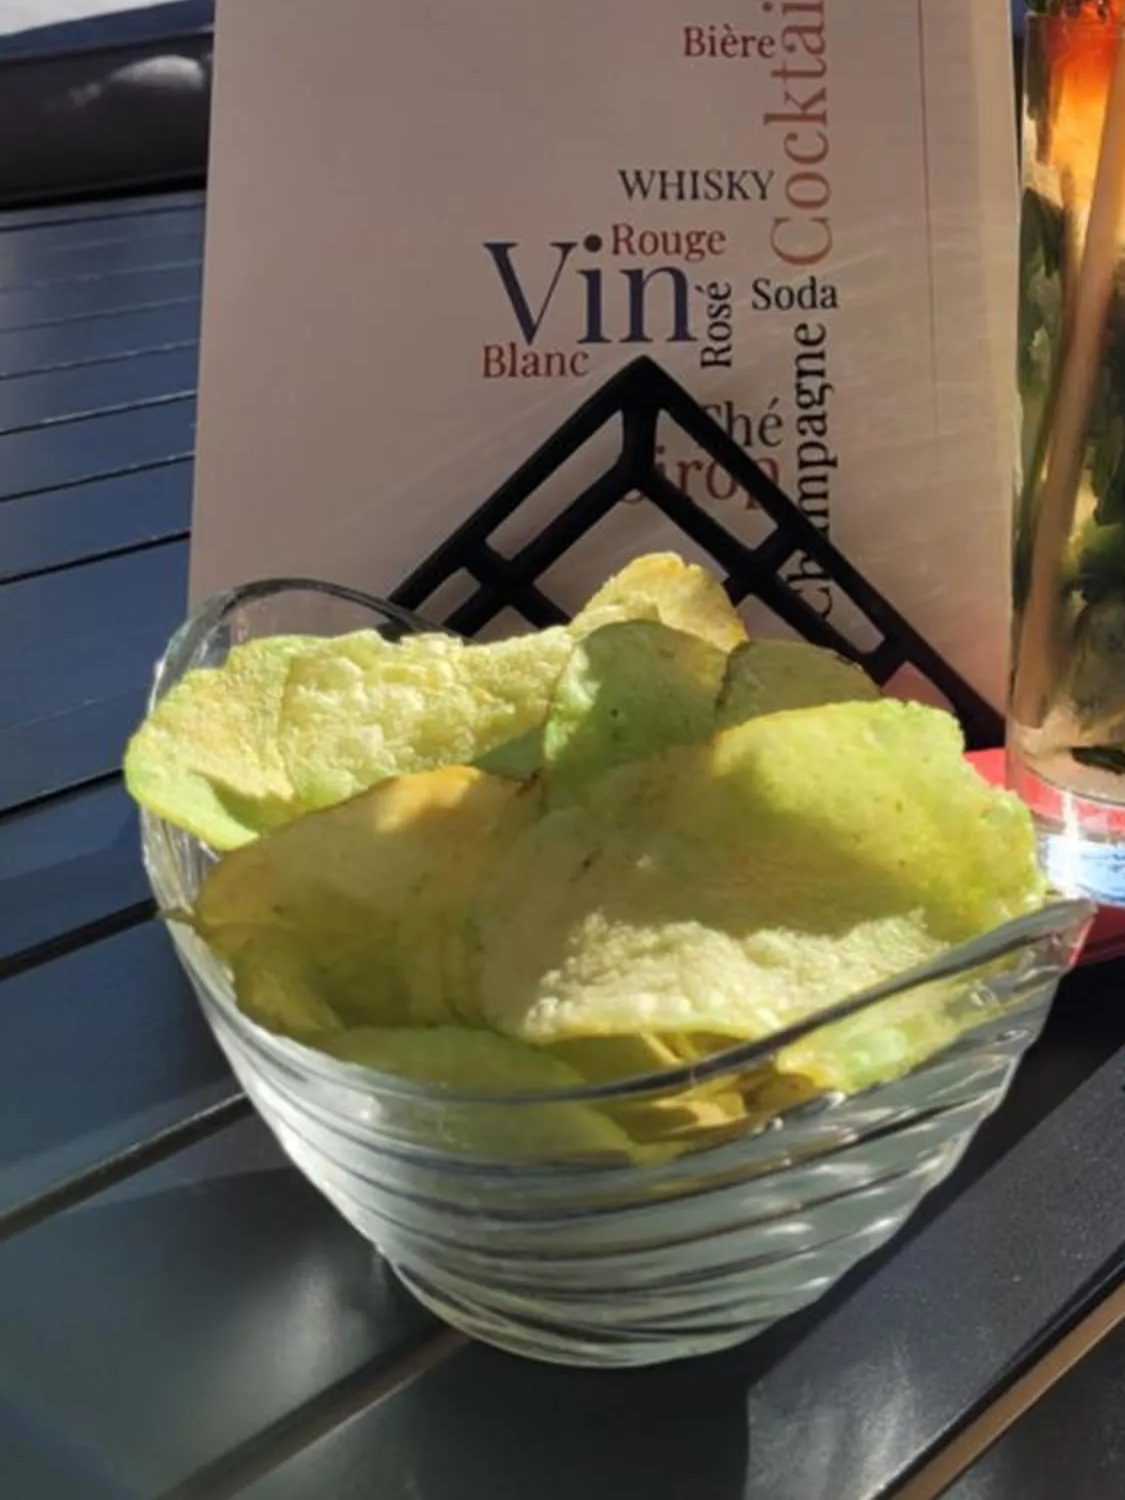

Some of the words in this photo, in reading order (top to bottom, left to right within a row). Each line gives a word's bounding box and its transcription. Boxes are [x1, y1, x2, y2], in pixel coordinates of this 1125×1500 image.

[683, 26, 777, 58] Bière
[618, 169, 776, 200] WHISKY
[611, 223, 727, 261] Rouge
[481, 233, 699, 346] Vin
[751, 276, 839, 311] Soda
[695, 280, 733, 368] Rosé
[481, 342, 590, 378] Blanc
